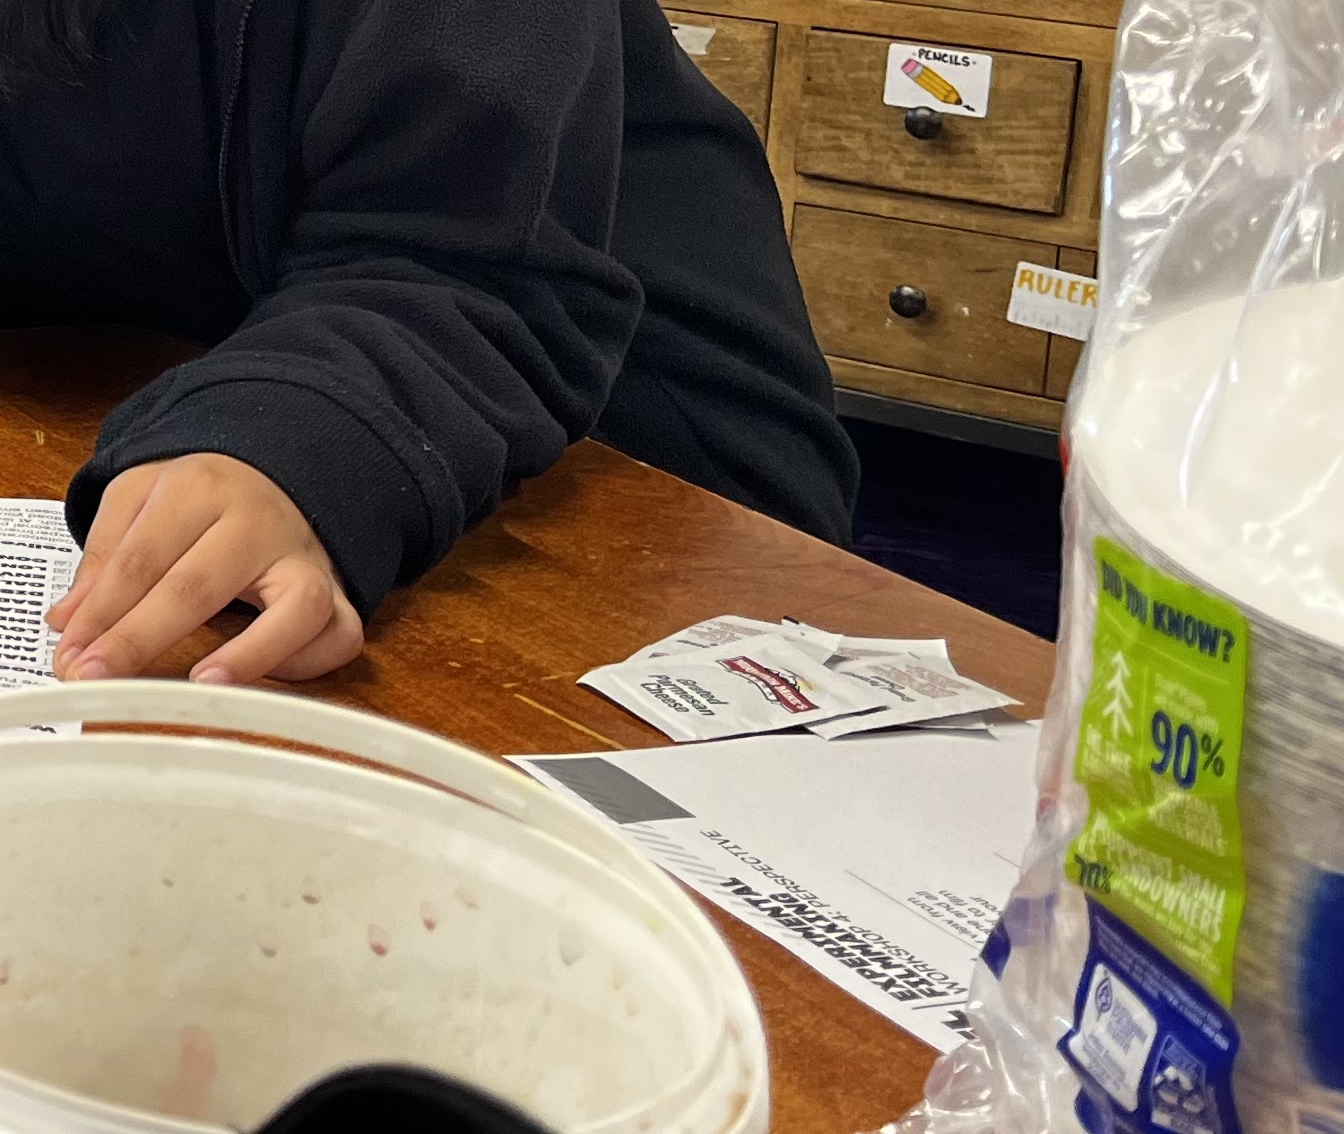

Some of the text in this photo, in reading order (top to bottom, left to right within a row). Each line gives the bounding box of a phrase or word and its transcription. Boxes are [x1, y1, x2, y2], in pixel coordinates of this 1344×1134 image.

[918, 48, 971, 67] PENCILS
[1152, 600, 1235, 663] KNOW?
[640, 682, 690, 712] Cheese
[648, 674, 716, 716] Parmesan
[1150, 709, 1225, 790] 90%
[699, 827, 830, 908] PERSPECTIVE
[719, 877, 924, 1003] EXPERIMENTAL
[767, 890, 952, 999] FILMMAKING
[846, 924, 969, 996] WORKSHOP
